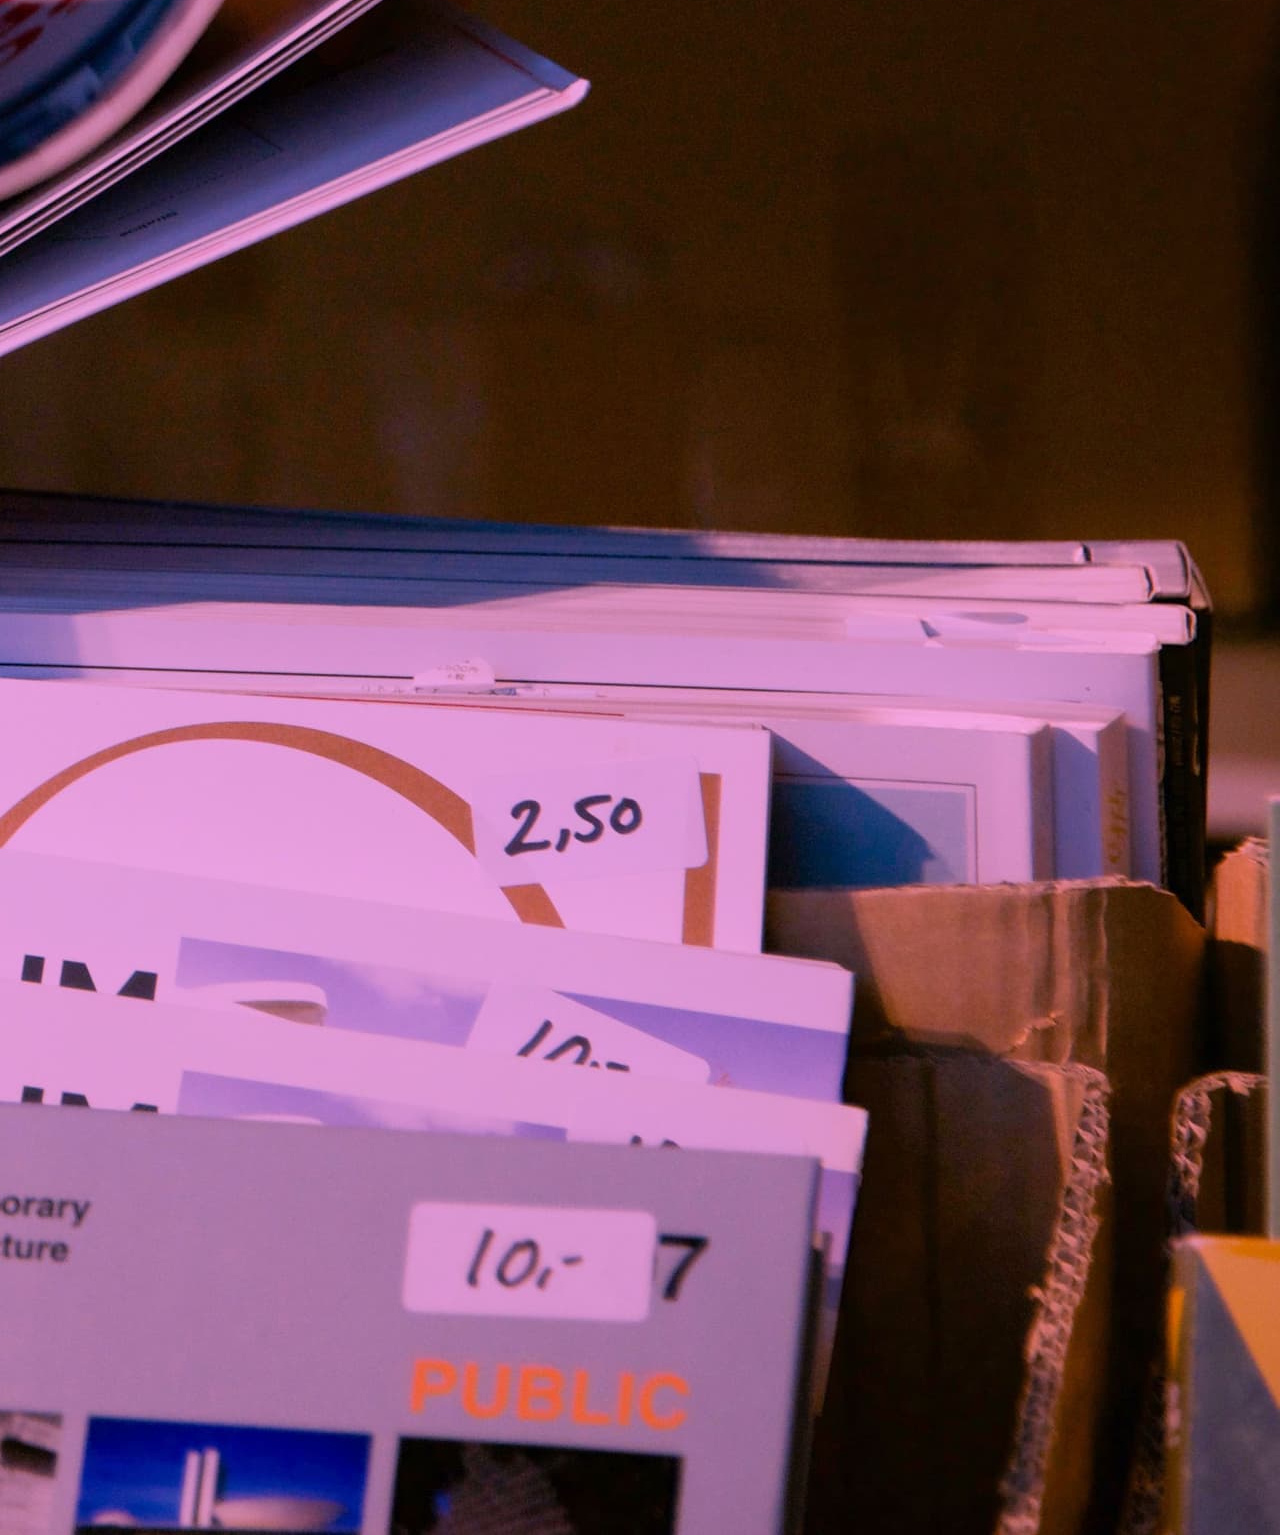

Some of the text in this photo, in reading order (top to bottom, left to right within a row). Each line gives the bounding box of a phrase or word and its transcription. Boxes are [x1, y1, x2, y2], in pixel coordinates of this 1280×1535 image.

[504, 794, 643, 856] 2,50
[466, 1228, 582, 1290] 10,-
[410, 1359, 689, 1430] PUBLIC
